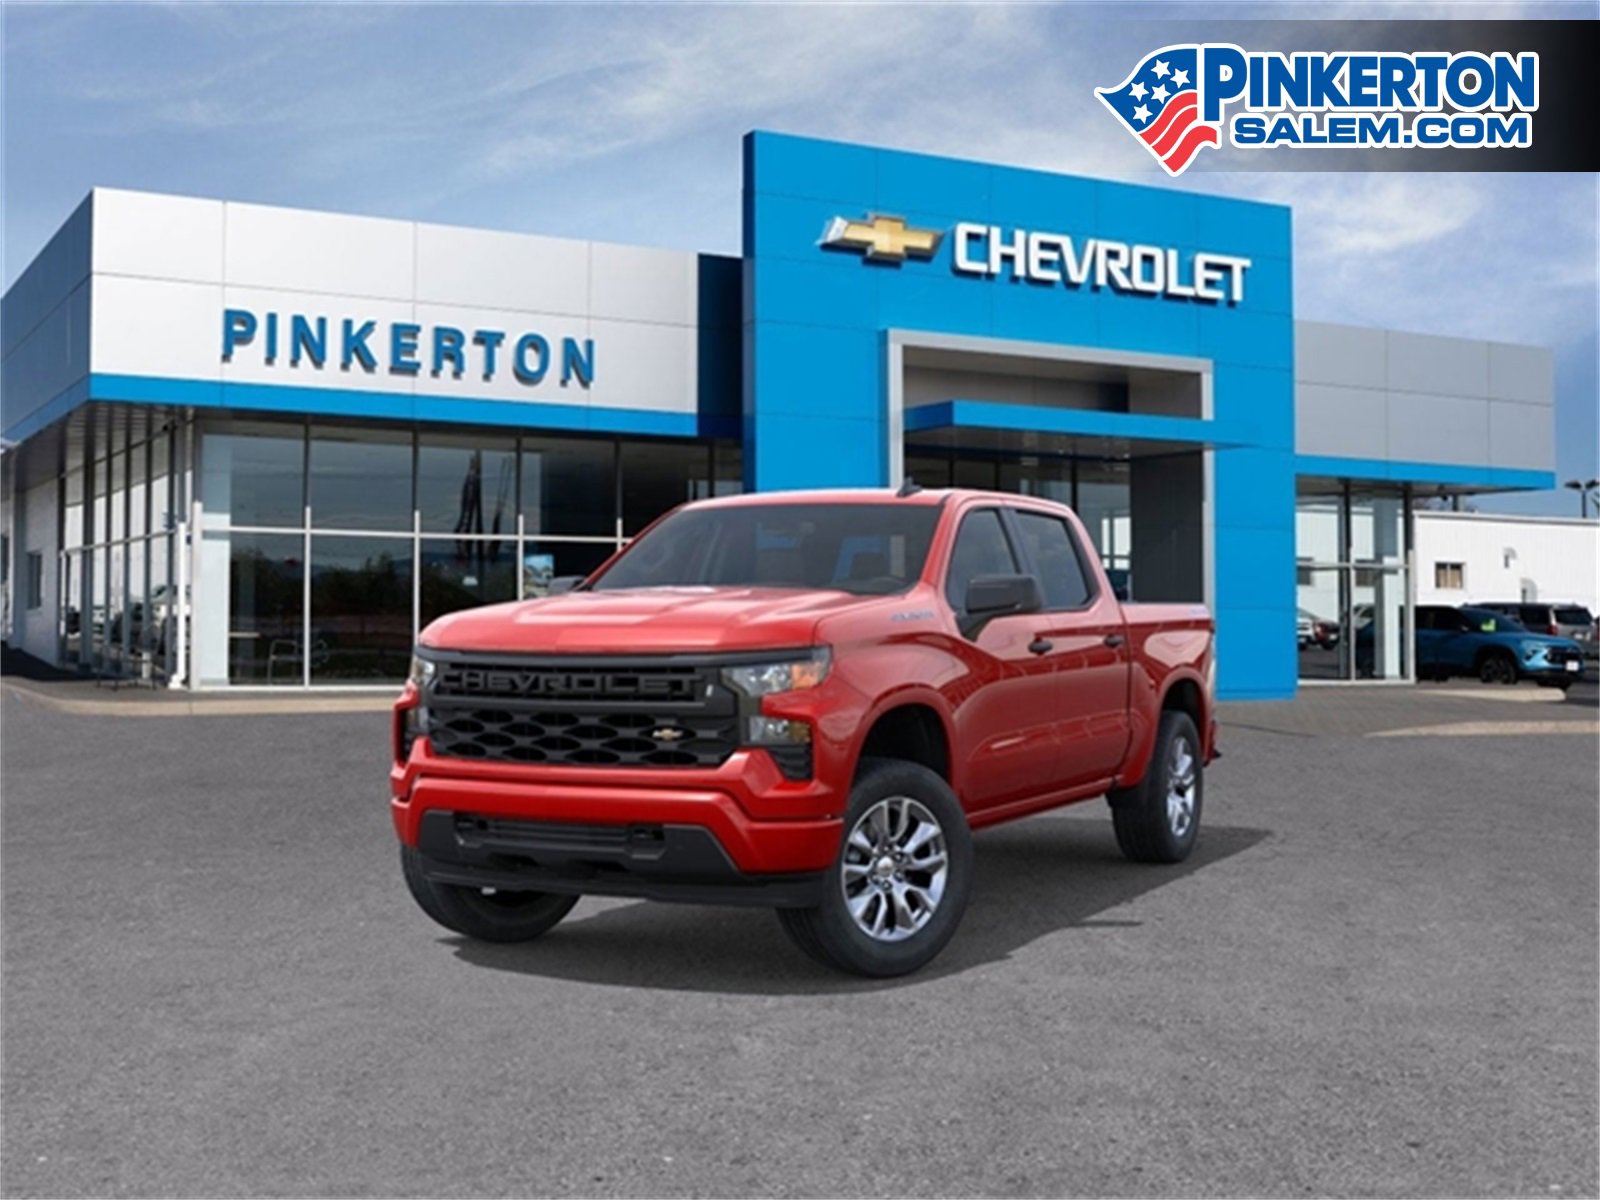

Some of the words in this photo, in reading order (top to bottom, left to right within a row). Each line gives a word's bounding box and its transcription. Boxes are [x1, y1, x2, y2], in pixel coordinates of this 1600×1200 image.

[953, 221, 1251, 303] CHEVROLET
[221, 308, 595, 387] PINKERTON
[438, 670, 701, 695] CHEVROLET
